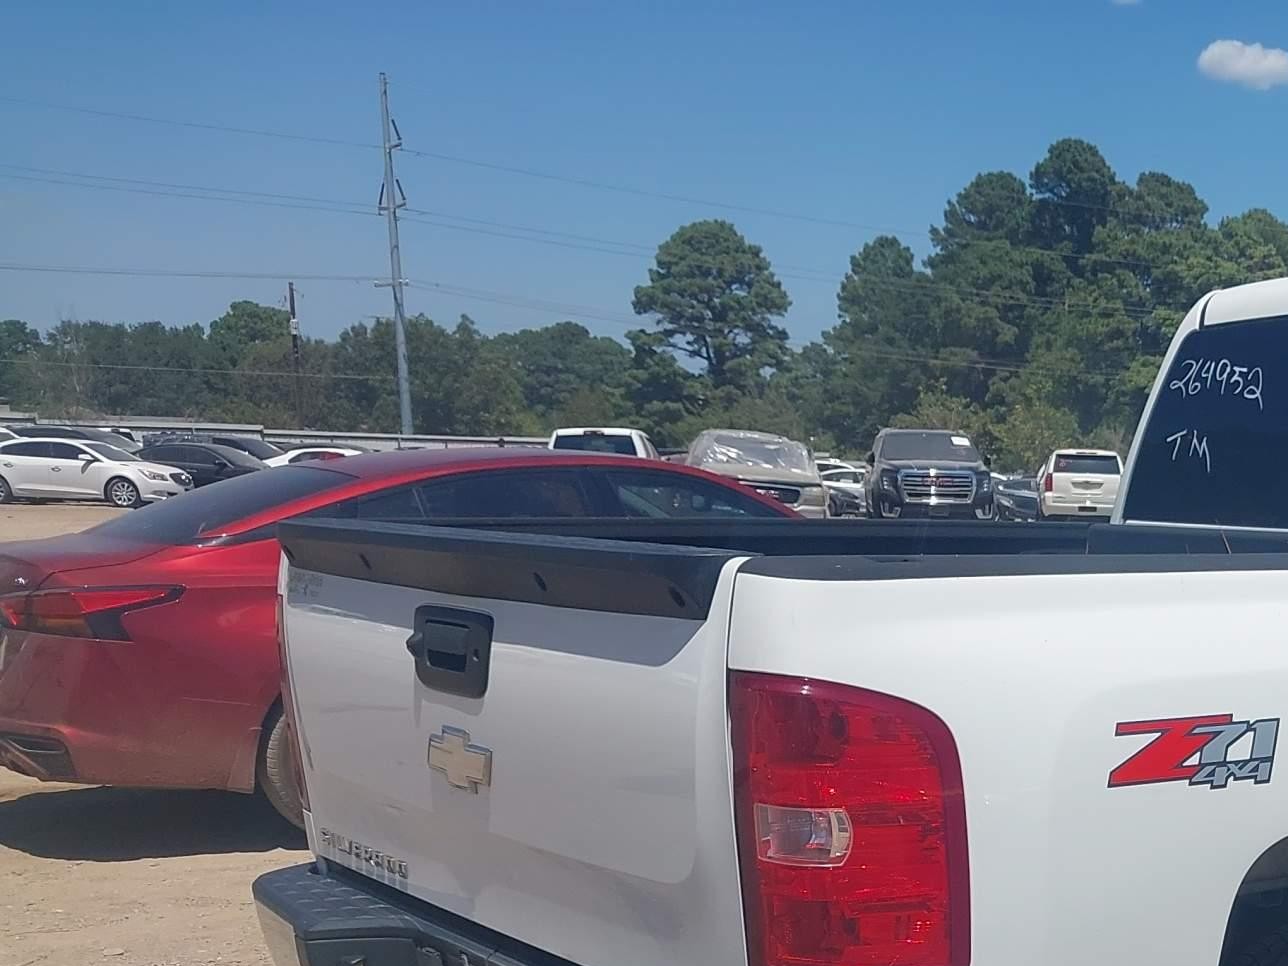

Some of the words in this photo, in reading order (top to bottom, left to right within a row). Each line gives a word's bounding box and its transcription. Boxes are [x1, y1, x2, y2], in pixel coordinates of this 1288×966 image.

[1169, 358, 1264, 411] 264952
[1166, 428, 1211, 473] TM
[1107, 713, 1280, 788] Z71
[320, 828, 409, 880] SILVERADO
